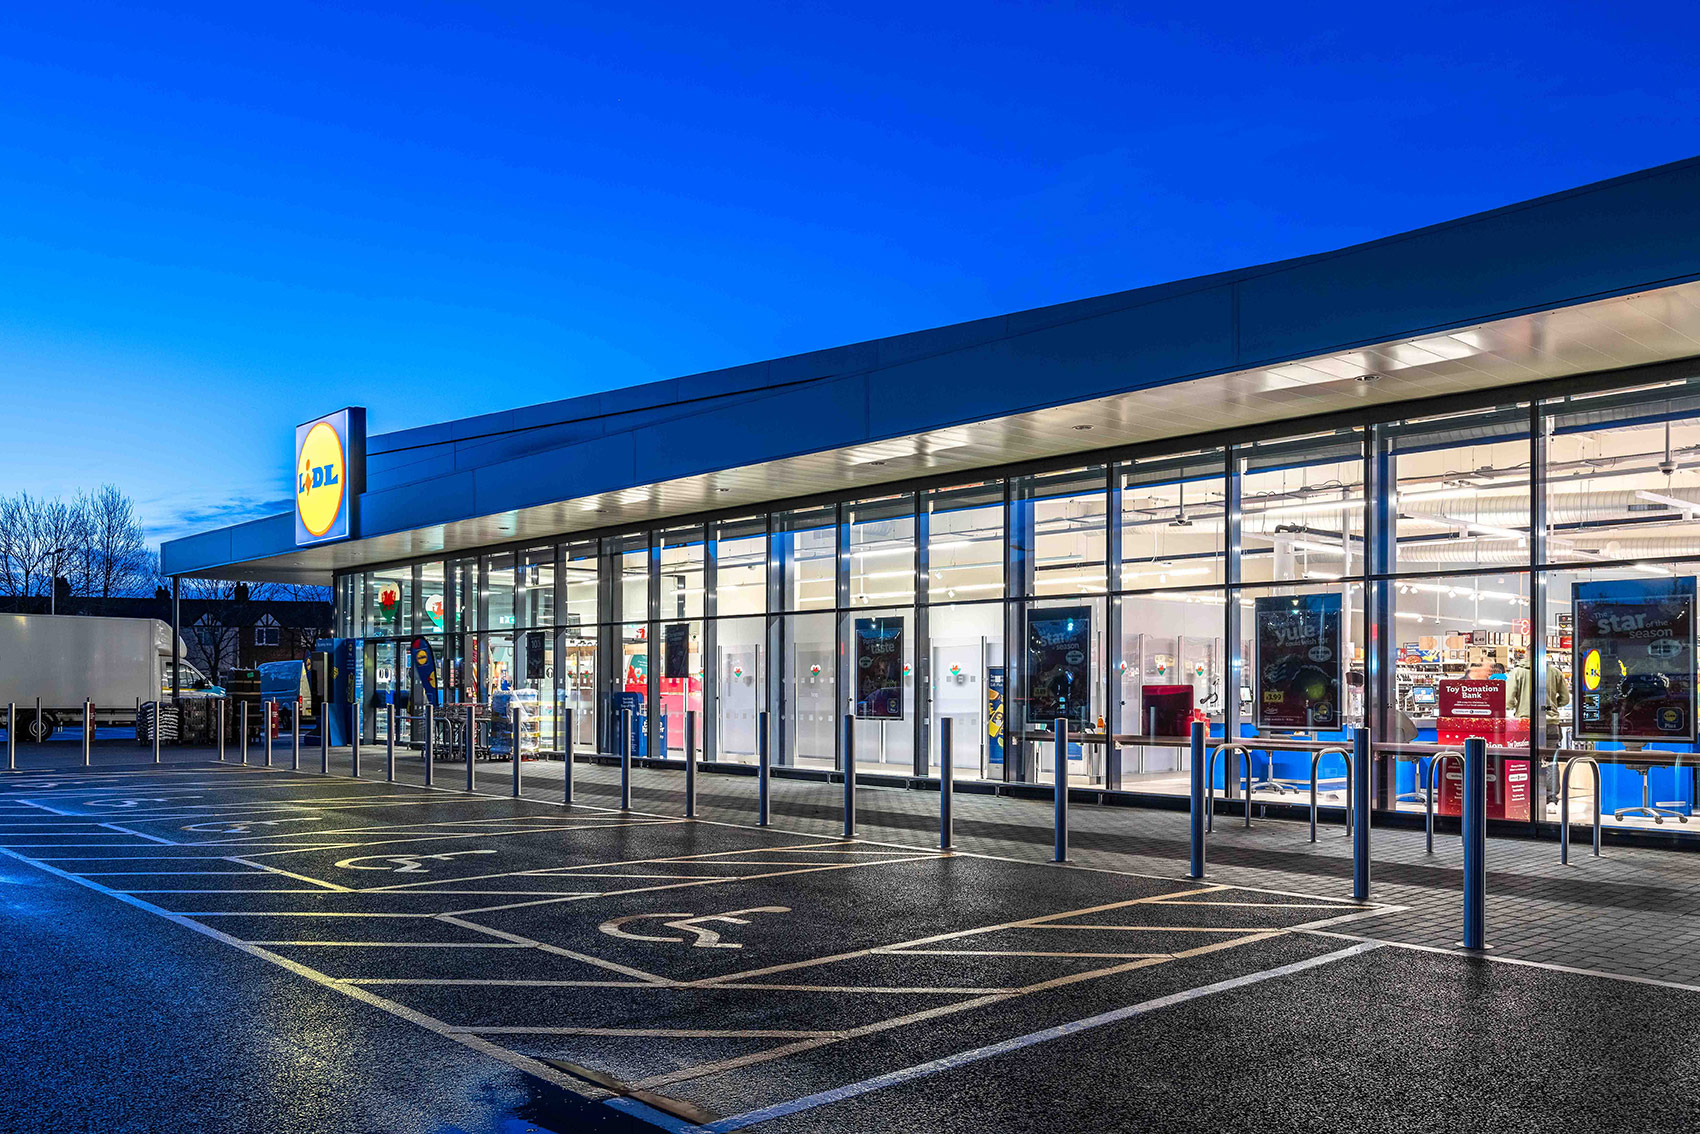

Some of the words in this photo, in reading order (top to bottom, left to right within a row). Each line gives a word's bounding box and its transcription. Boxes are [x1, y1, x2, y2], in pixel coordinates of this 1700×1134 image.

[1597, 613, 1647, 635] star
[1629, 629, 1673, 639] season
[1446, 685, 1460, 694] Toy
[1461, 684, 1499, 693] Donation
[1462, 691, 1482, 699] Bank
